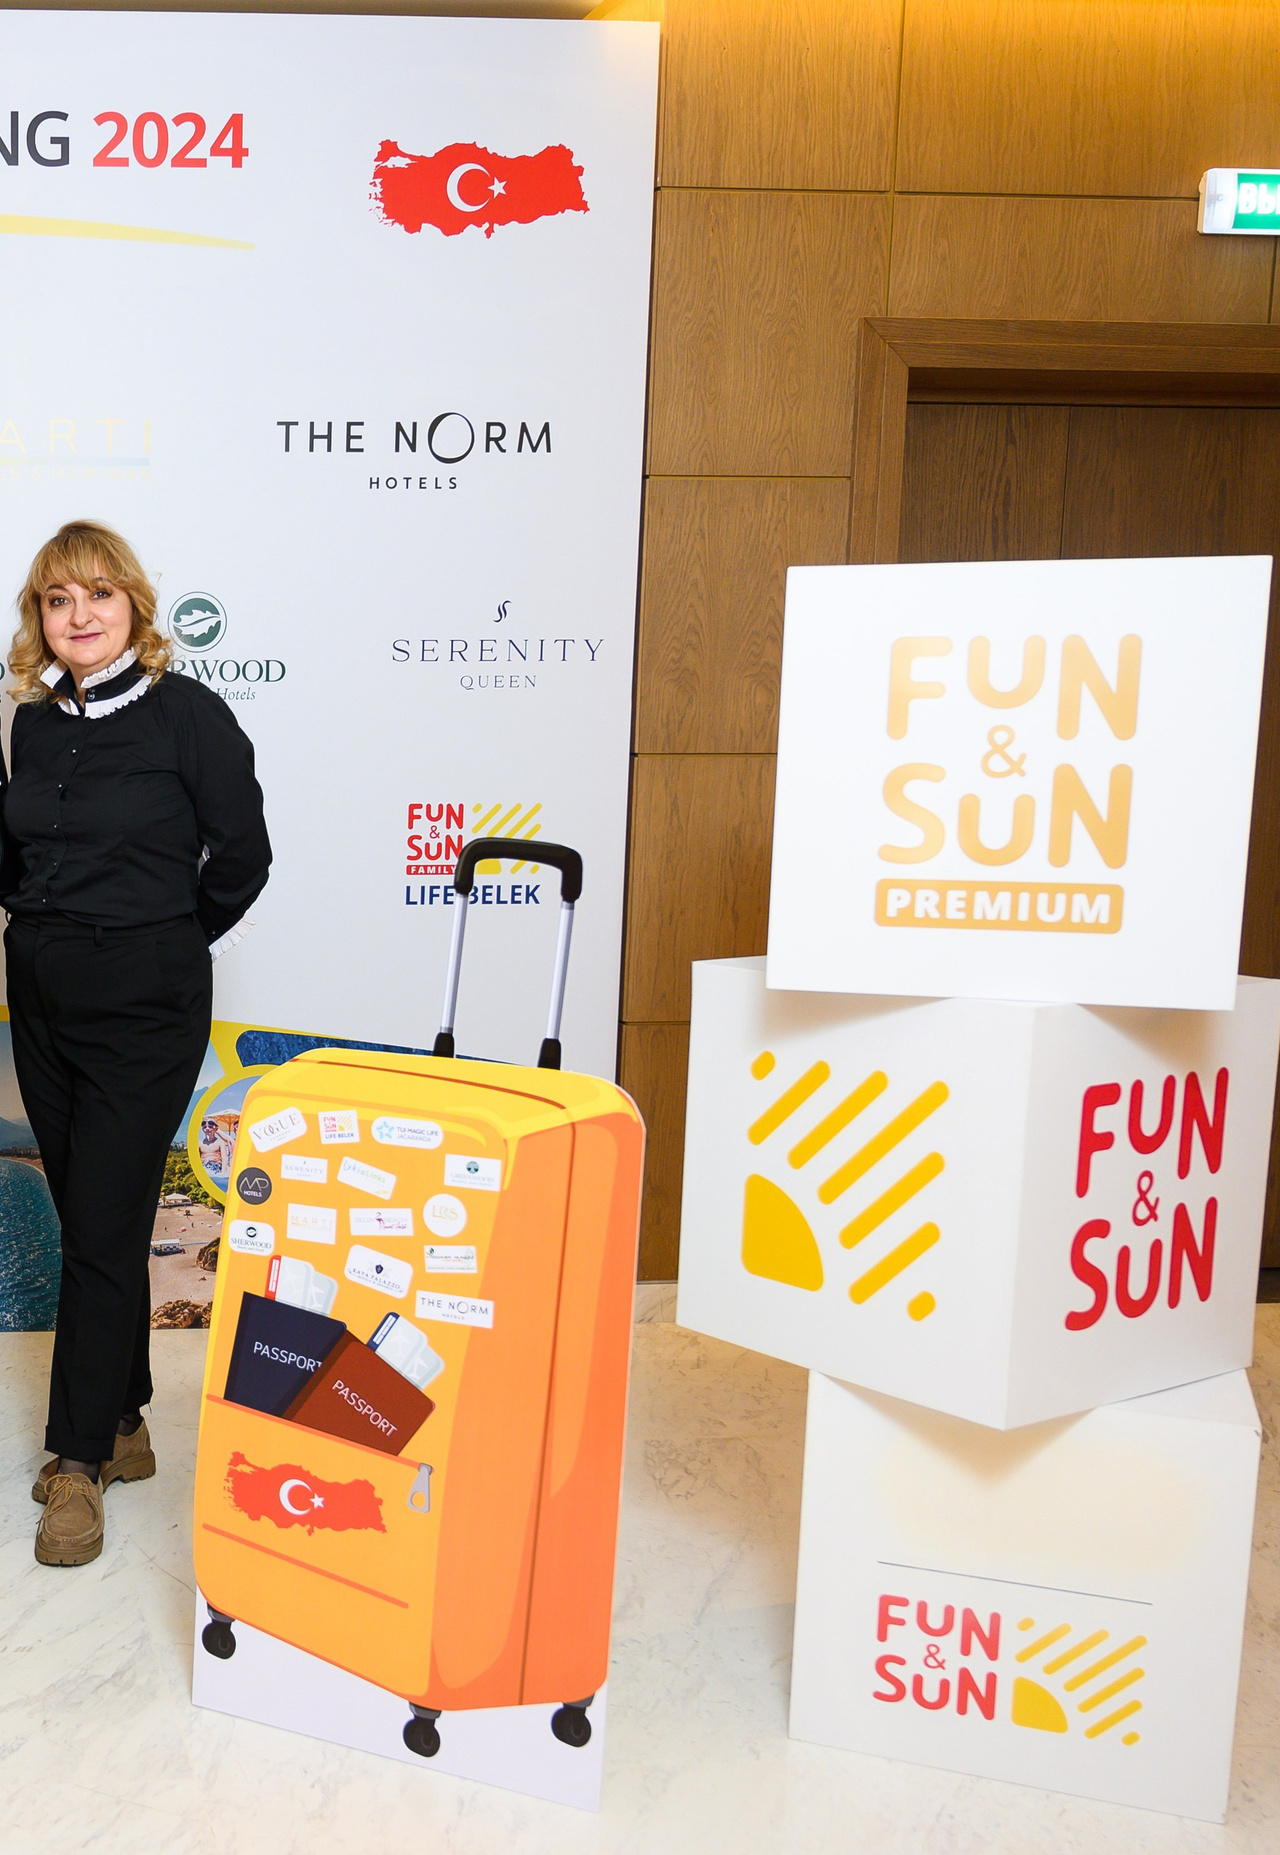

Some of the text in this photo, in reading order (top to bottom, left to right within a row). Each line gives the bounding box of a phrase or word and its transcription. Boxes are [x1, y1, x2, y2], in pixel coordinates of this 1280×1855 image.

[93, 111, 249, 168] 2024
[276, 411, 551, 465] THE NORM
[369, 477, 458, 490] HOTELS
[392, 639, 604, 663] SERENITY
[460, 675, 537, 690] QUEEN
[886, 633, 1143, 741] FUN
[981, 724, 1027, 778] &
[408, 803, 464, 830] FUN
[429, 825, 440, 839] &
[411, 866, 456, 874] FAMILY
[405, 885, 455, 905] LIFE
[886, 887, 1111, 925] PREMIUM
[253, 1113, 300, 1140] VOGUE
[1075, 1066, 1229, 1198] FUN
[1132, 1170, 1160, 1226] &
[421, 1297, 489, 1315] THE NORM
[332, 1379, 397, 1436] PASSPORT
[876, 1593, 1001, 1661] FUN
[923, 1643, 946, 1670] &
